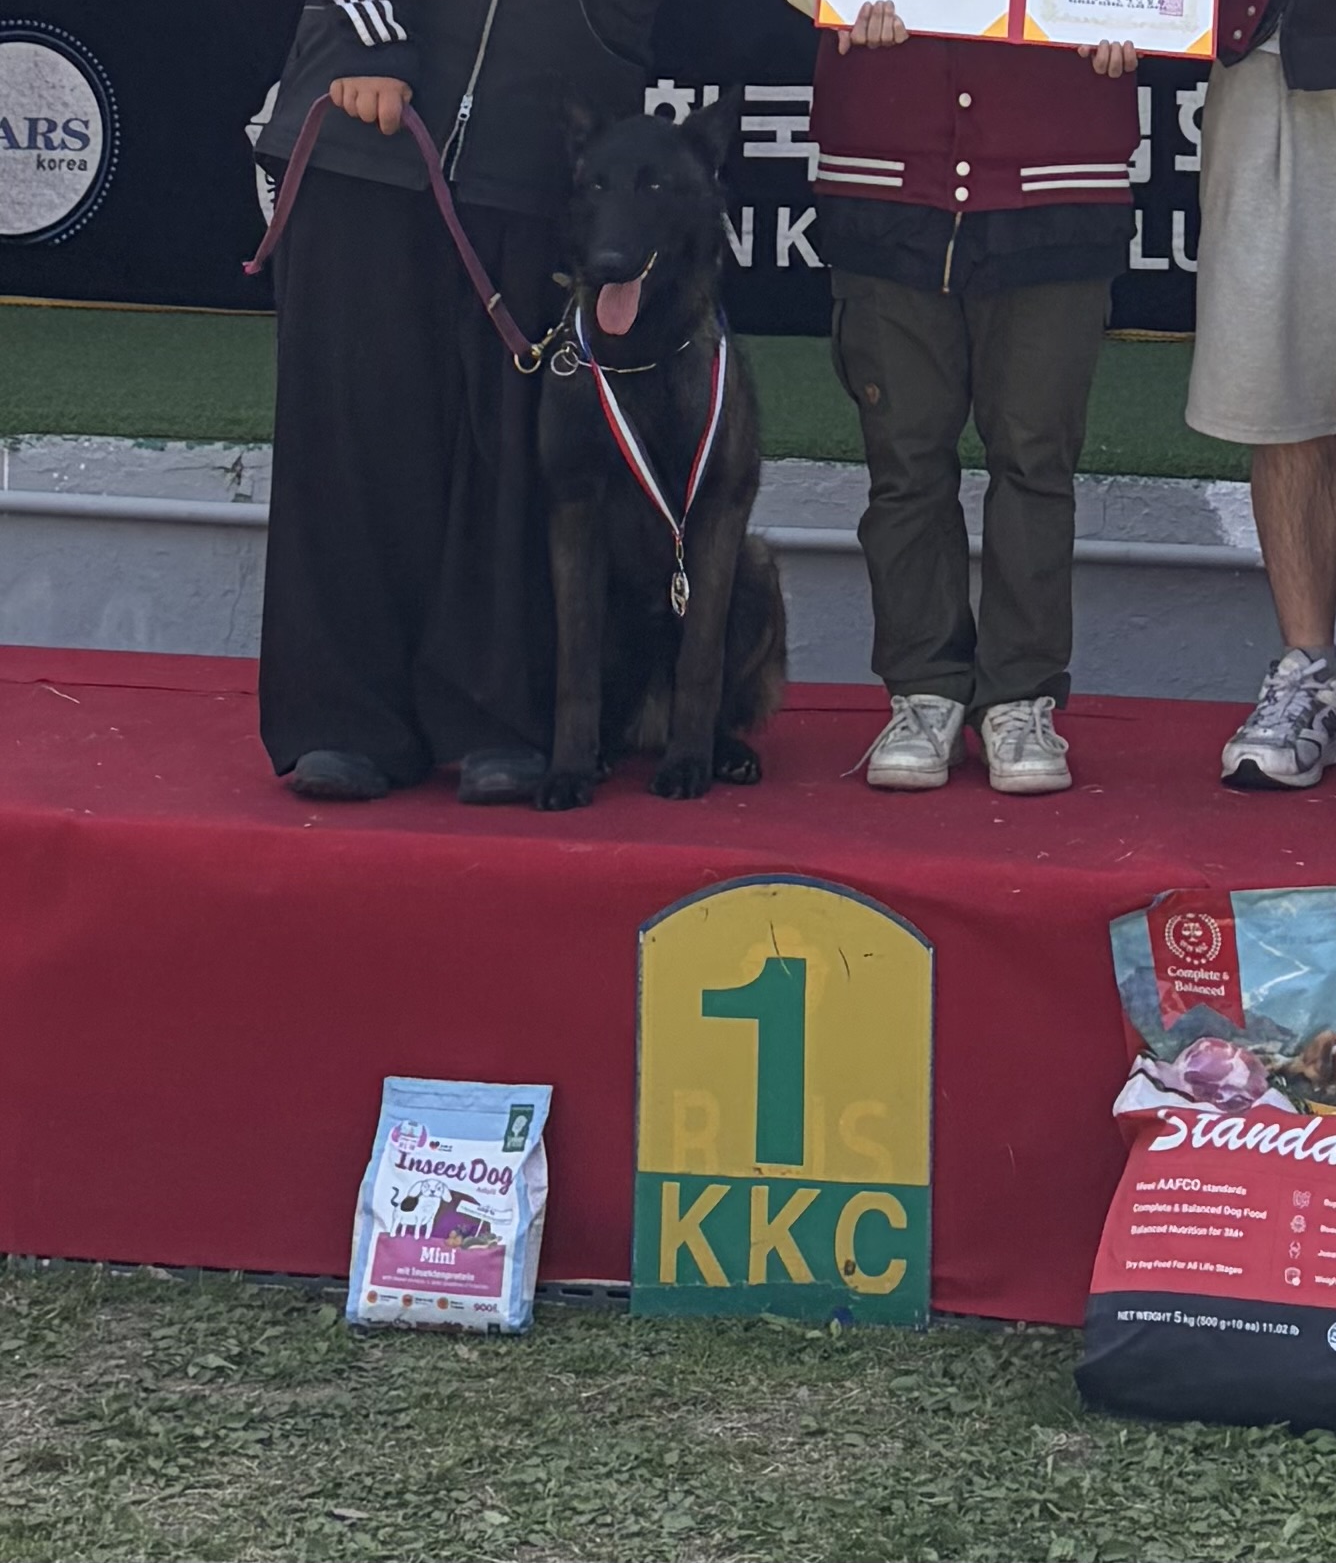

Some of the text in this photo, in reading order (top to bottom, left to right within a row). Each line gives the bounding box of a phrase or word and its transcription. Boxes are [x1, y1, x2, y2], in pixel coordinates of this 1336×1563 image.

[36, 154, 88, 171] korea
[1167, 965, 1221, 982] Complete
[702, 957, 807, 1166] 1
[1157, 1178, 1201, 1191] AAFCO
[1132, 1203, 1172, 1214] Complete
[1182, 1204, 1222, 1215] Balanced
[1223, 1205, 1242, 1219] Dog
[1244, 1207, 1267, 1220] Food
[659, 1181, 908, 1295] KKC
[1168, 1224, 1208, 1236] Nutrition
[419, 1245, 457, 1266] Mini
[1173, 1310, 1182, 1324] 5
[1182, 1313, 1195, 1327] kg
[1196, 1315, 1218, 1328] (500
[1262, 1322, 1288, 1335] 11.02
